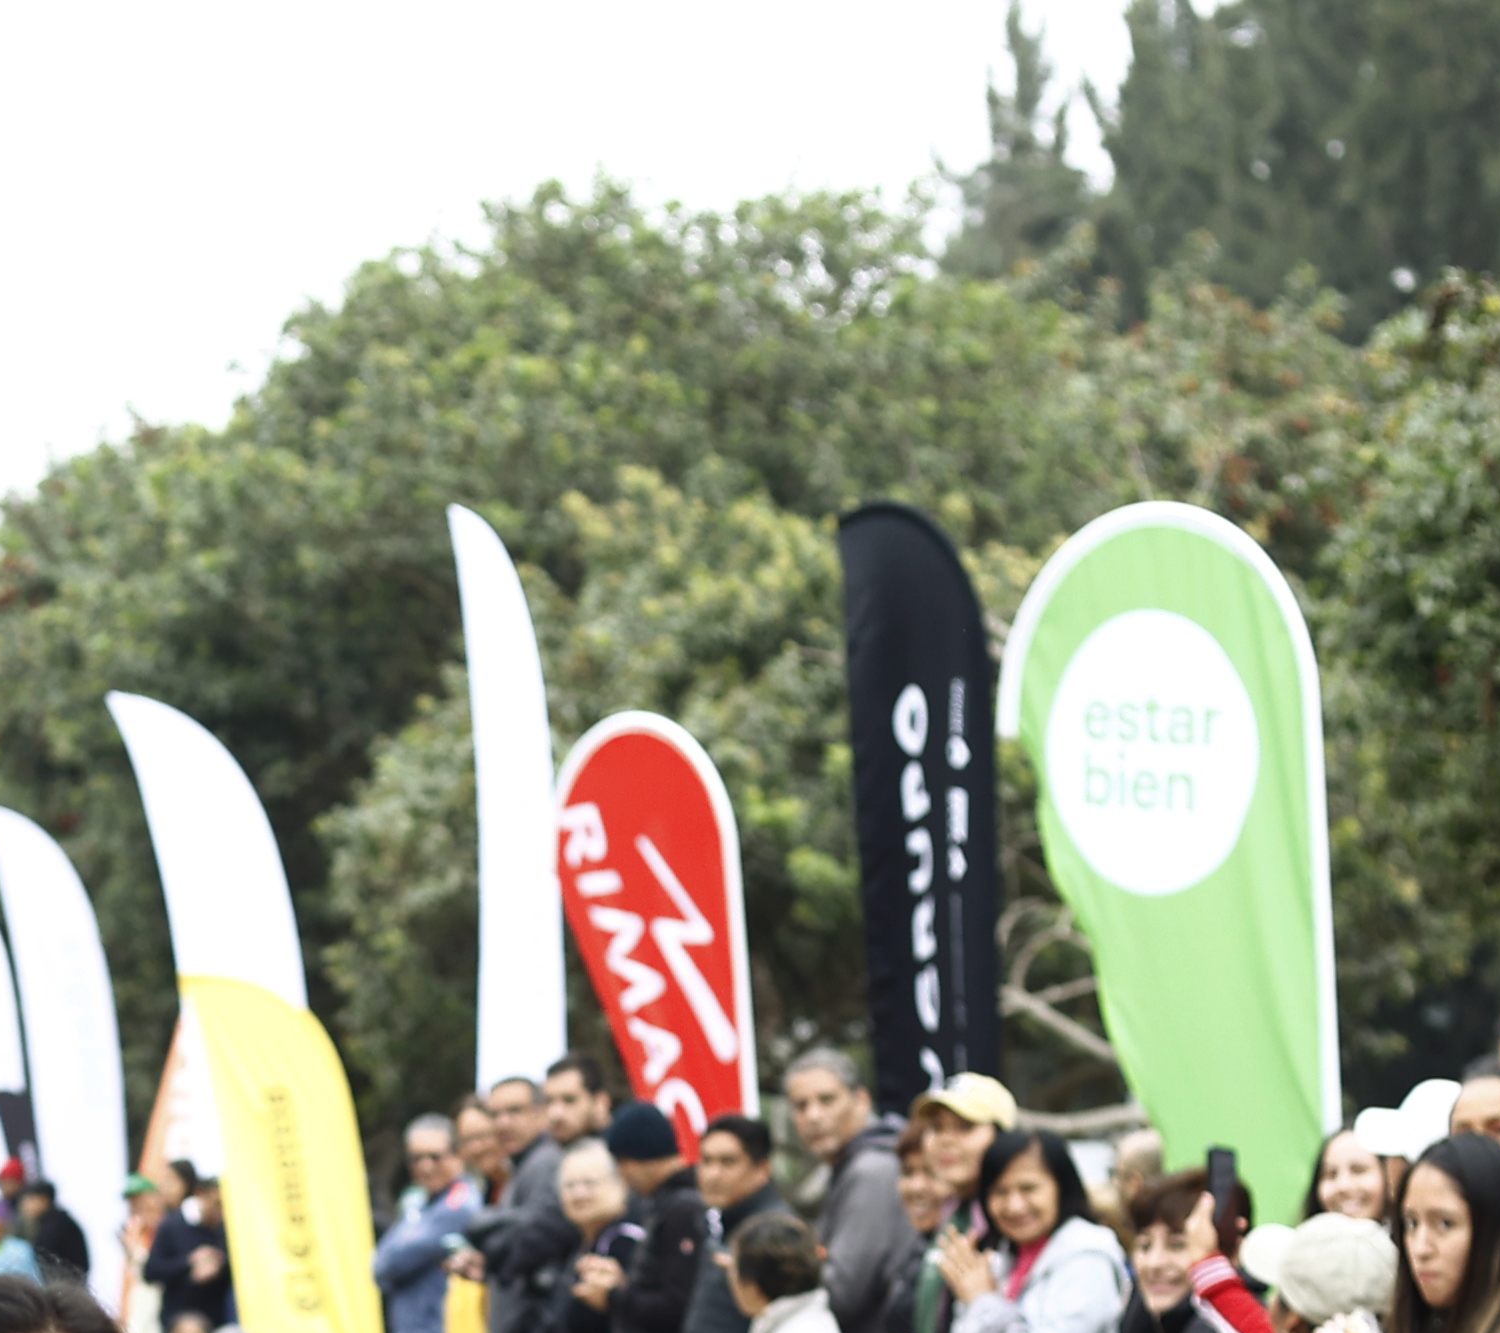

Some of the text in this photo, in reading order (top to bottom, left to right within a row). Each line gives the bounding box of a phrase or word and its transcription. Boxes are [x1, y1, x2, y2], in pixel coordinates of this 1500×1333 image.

[1083, 699, 1222, 746] estar
[1083, 751, 1195, 811] bien
[557, 802, 708, 1126] RIMAC
